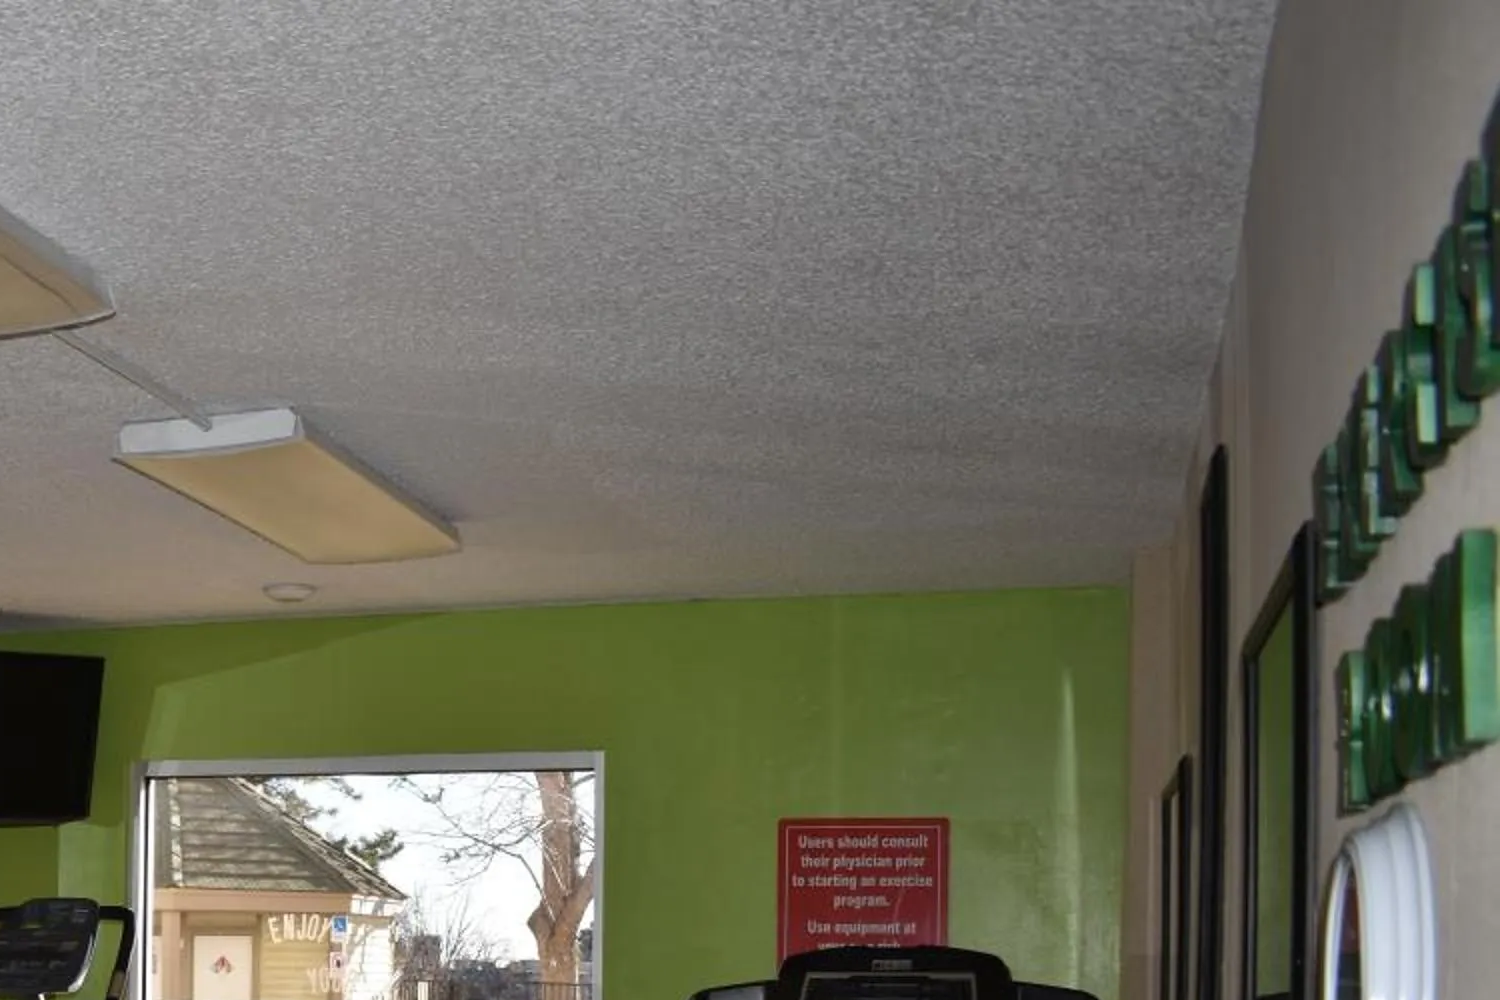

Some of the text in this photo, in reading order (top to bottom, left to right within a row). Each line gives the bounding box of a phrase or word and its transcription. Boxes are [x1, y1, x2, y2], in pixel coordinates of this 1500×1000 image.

[798, 834, 929, 849] Users should consult
[801, 854, 926, 871] their physician prior
[791, 874, 934, 890] to starting an exercise
[833, 895, 891, 910] program.
[267, 913, 332, 944] ENJOY
[806, 919, 917, 937] Use equipment at
